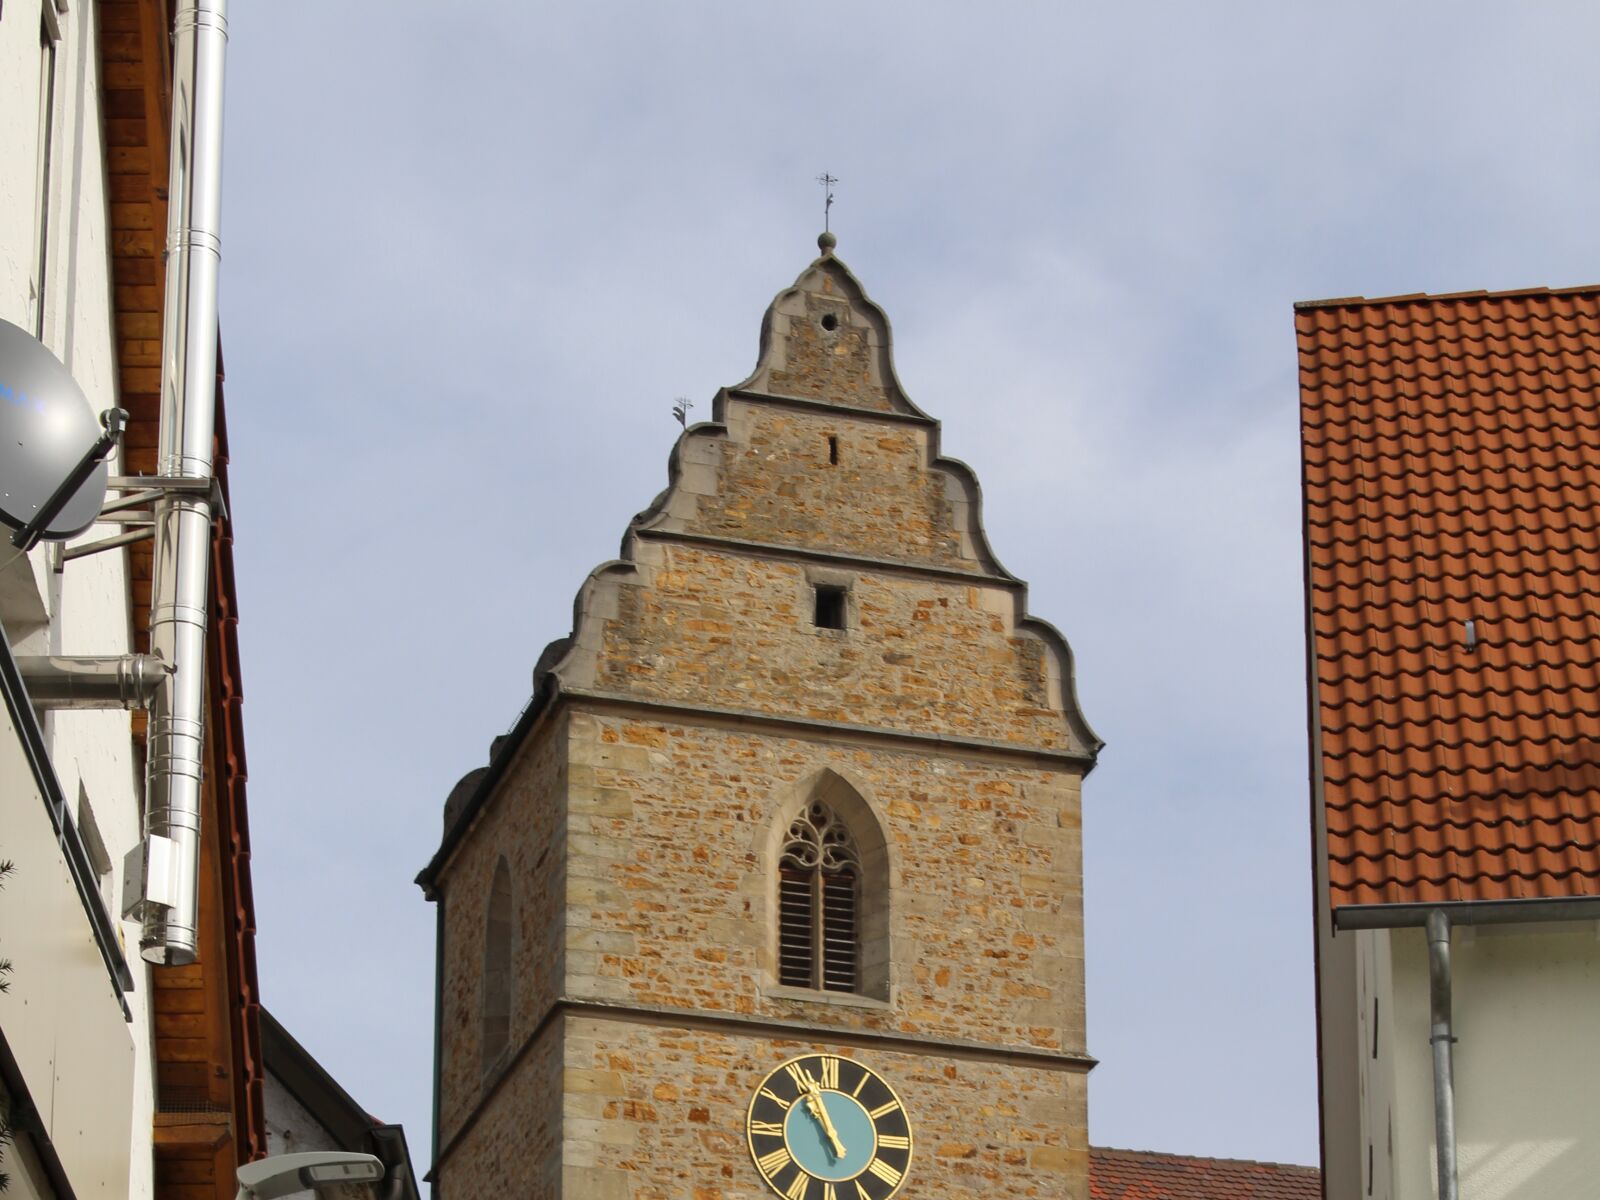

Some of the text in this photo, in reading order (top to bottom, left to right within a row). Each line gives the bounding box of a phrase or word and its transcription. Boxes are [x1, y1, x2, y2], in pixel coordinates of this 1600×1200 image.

[785, 1062, 809, 1094] XI
[820, 1056, 839, 1089] XII
[853, 1072, 871, 1098] I
[760, 1086, 791, 1110] X
[870, 1100, 900, 1120] II
[751, 1120, 783, 1136] IX
[878, 1134, 909, 1149] III
[758, 1147, 792, 1179] VIII
[868, 1157, 902, 1188] IIII
